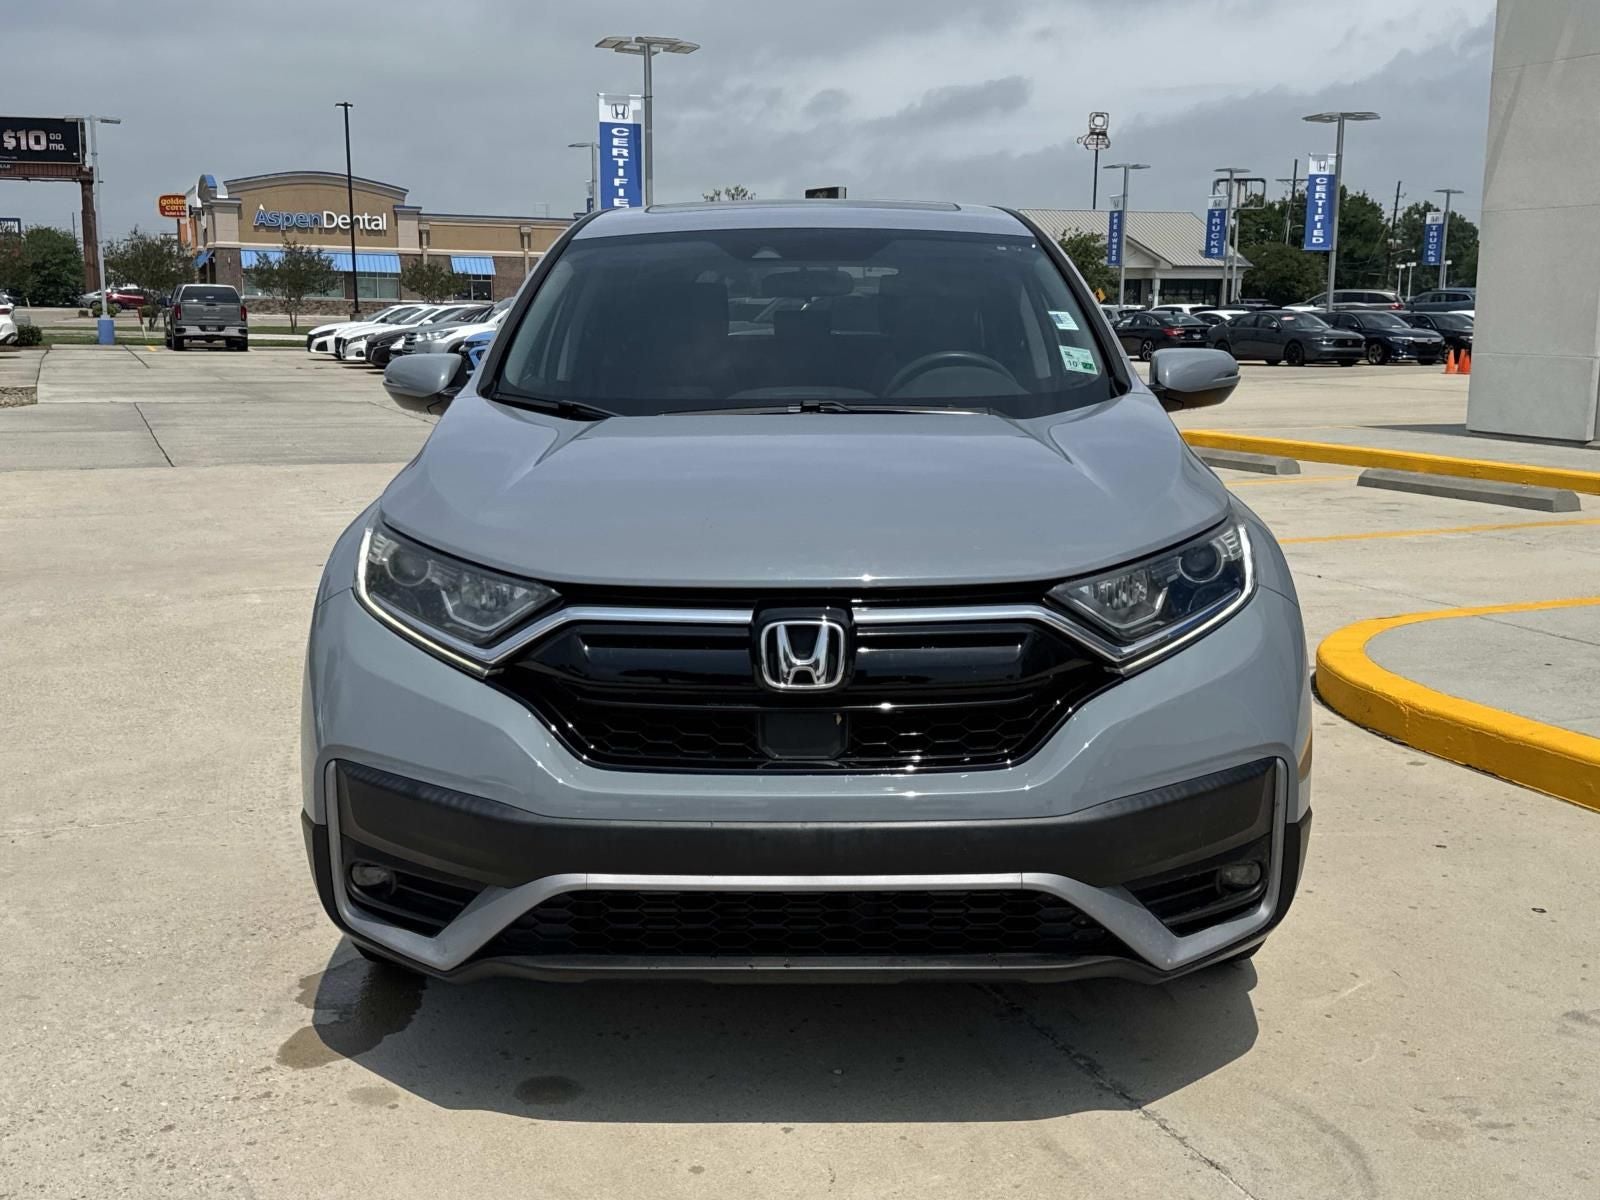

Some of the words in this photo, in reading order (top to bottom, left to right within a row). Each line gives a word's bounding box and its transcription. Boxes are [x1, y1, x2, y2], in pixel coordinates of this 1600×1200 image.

[3, 129, 47, 151] $10
[611, 127, 630, 208] CERTIFIE
[253, 203, 323, 231] Aspen
[322, 210, 387, 231] Dental
[1311, 177, 1328, 244] CERTIFIED
[1210, 210, 1221, 254] TRUCKS
[1427, 225, 1438, 262] TRUCKS
